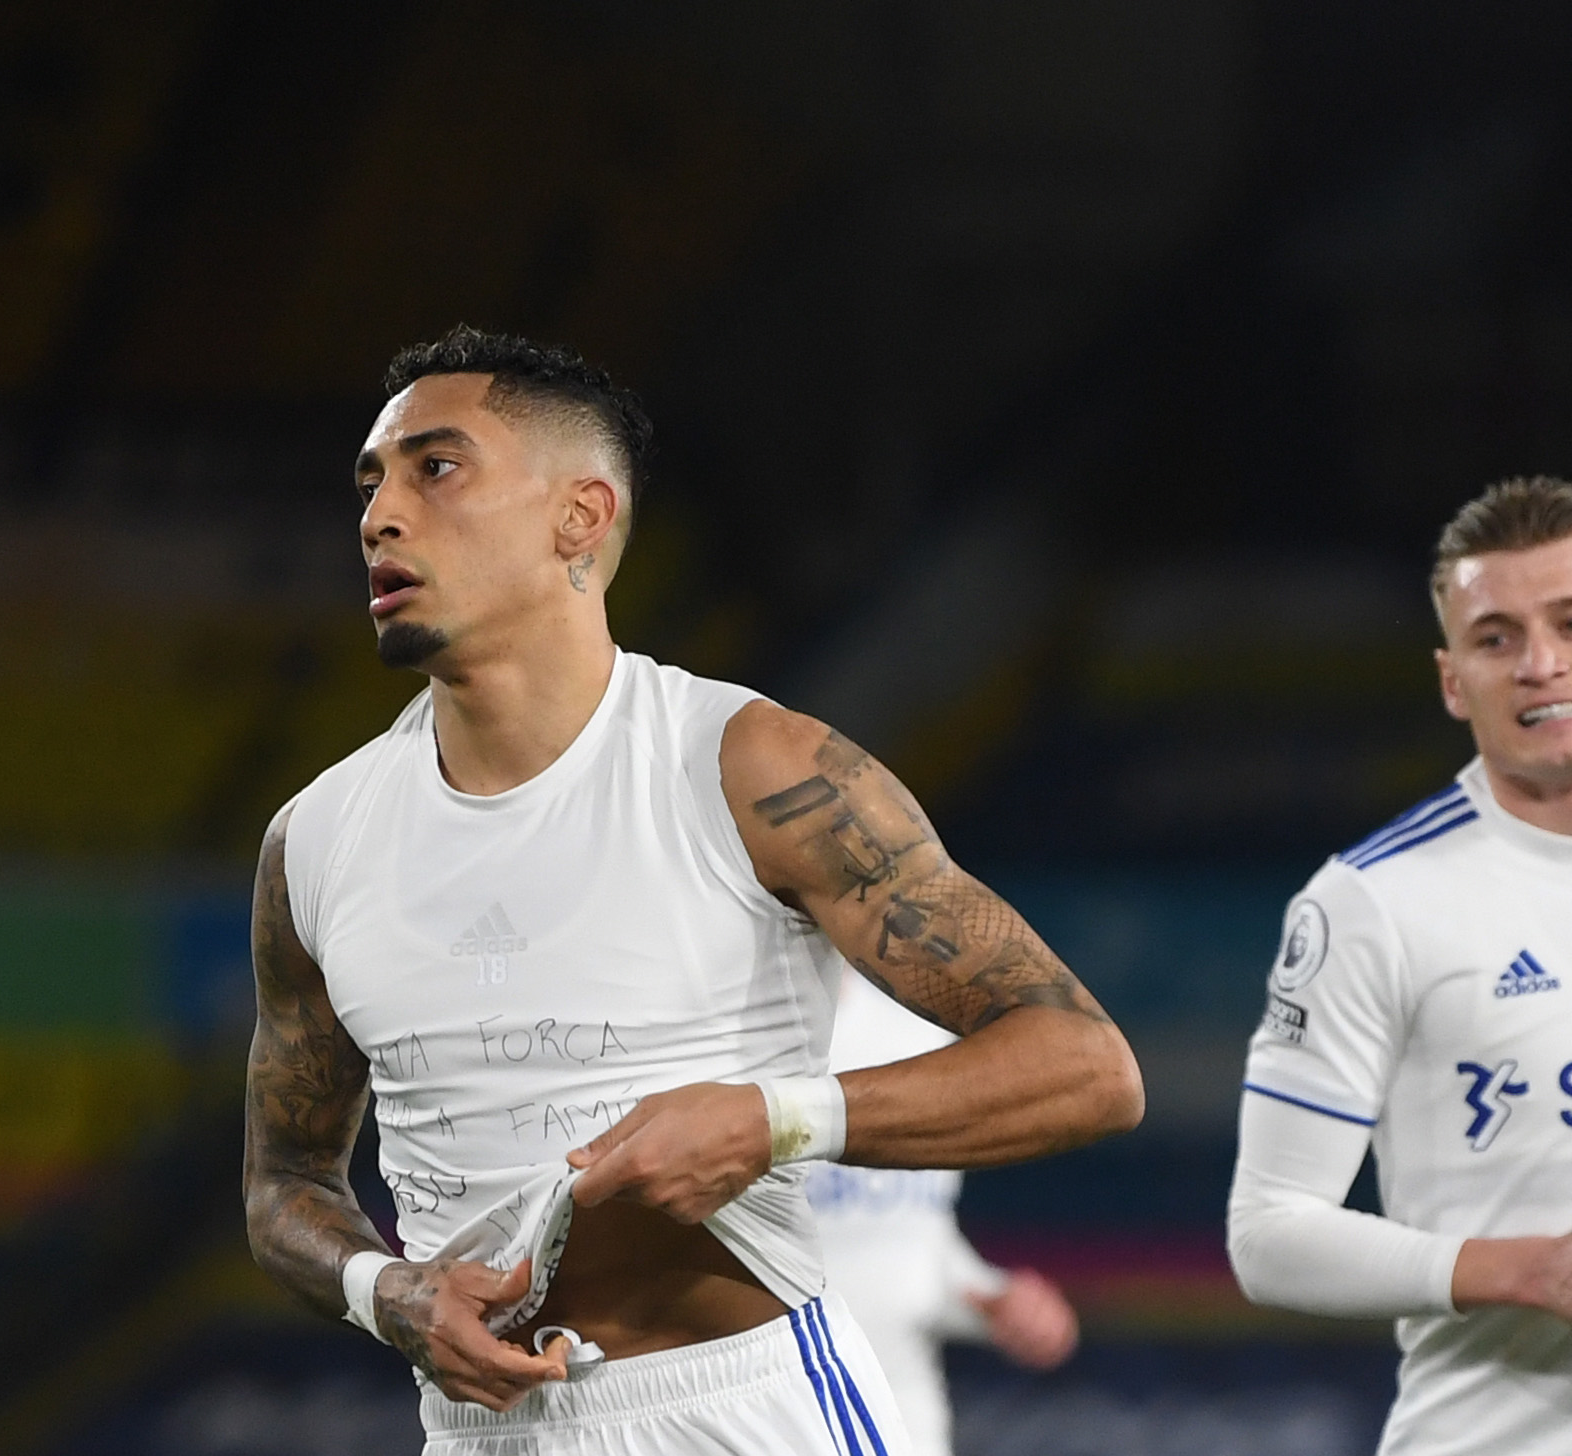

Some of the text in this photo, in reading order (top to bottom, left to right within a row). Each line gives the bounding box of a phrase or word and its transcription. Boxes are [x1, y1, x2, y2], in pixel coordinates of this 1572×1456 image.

[475, 955, 509, 986] 18
[1494, 976, 1560, 999] adidas
[477, 1014, 629, 1066] FORÇA
